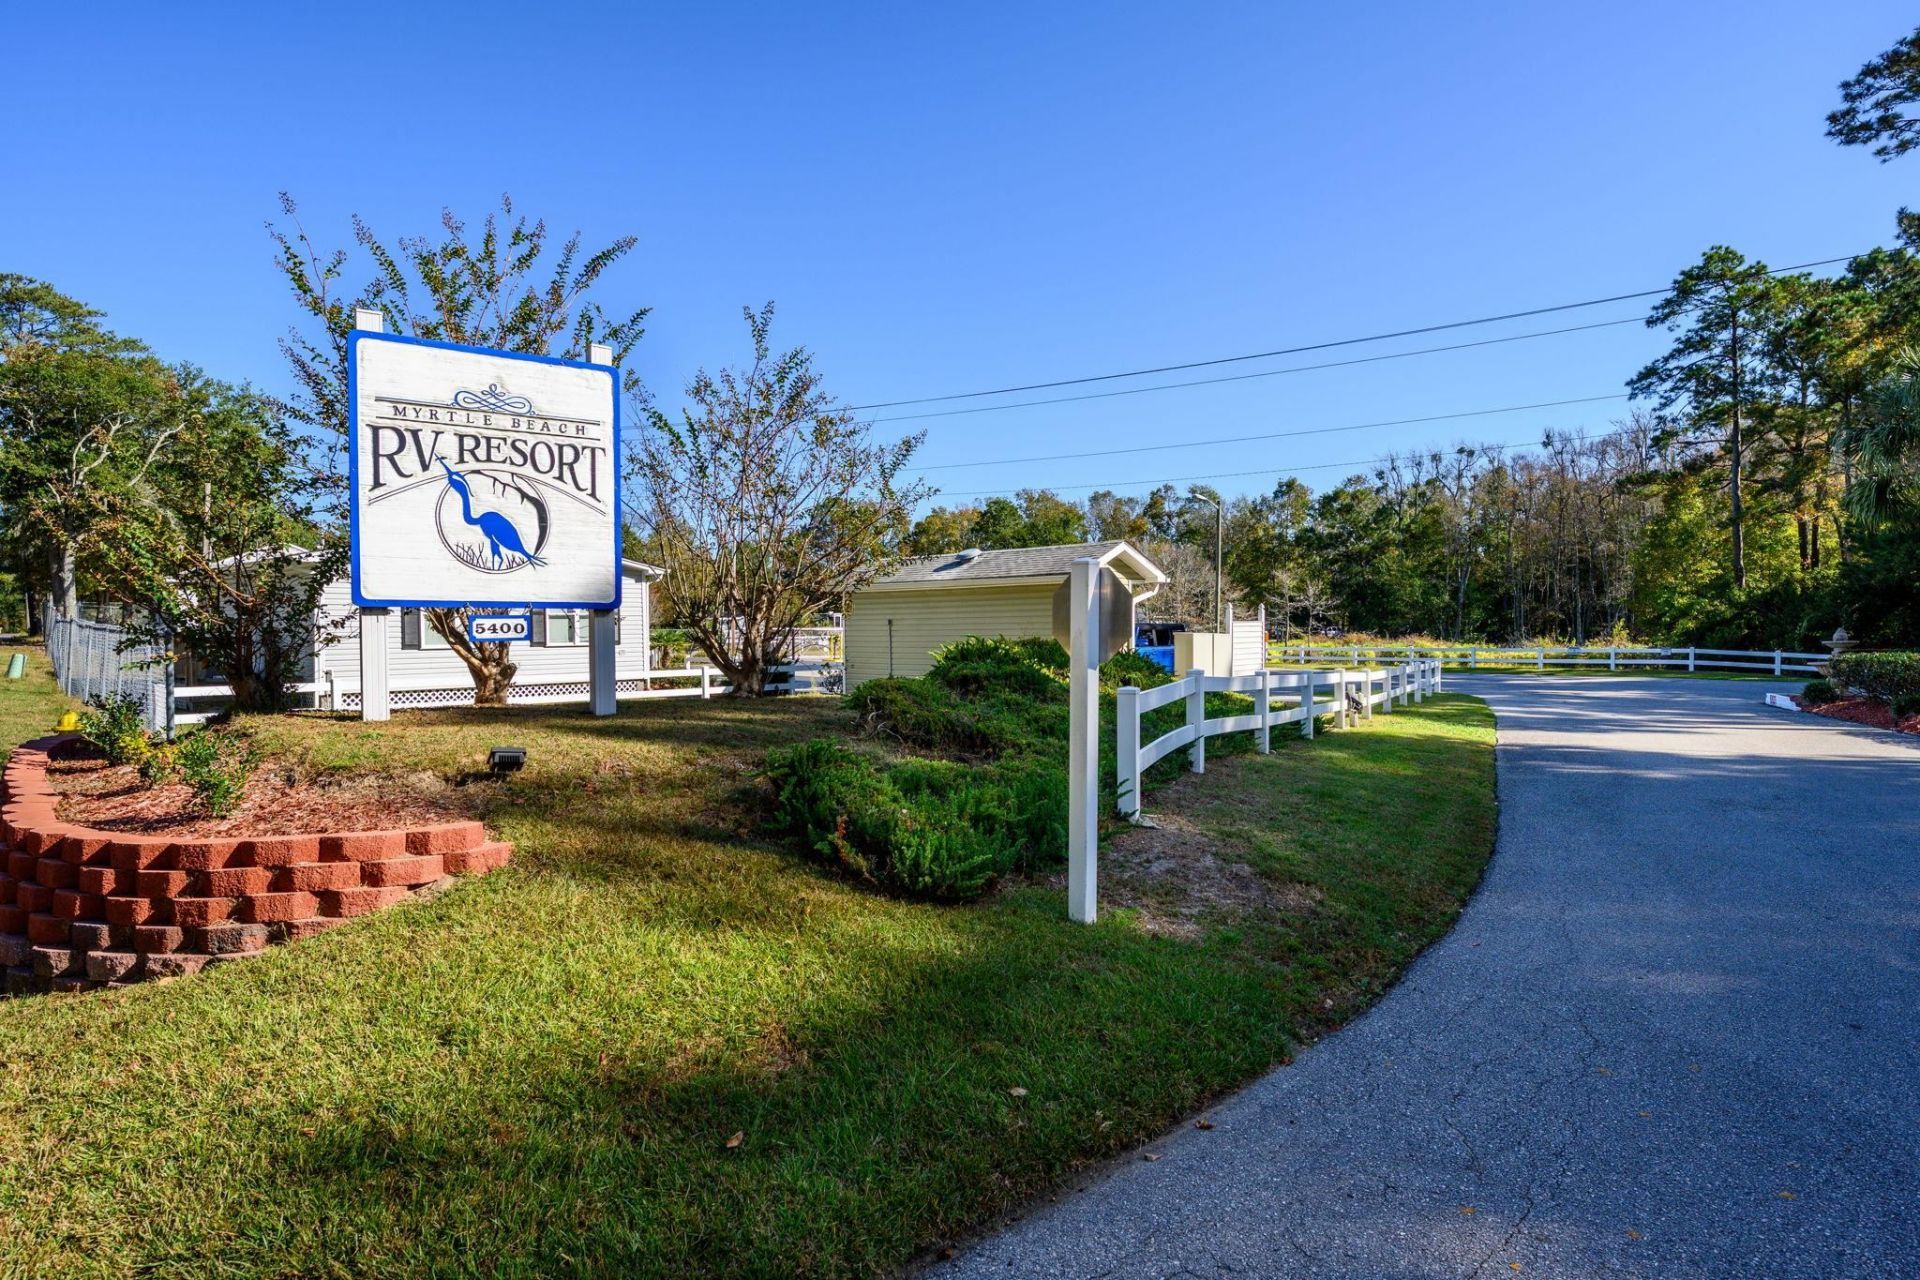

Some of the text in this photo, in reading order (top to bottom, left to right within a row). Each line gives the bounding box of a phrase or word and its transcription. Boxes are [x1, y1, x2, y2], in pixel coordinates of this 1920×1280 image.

[392, 405, 586, 436] MYRTLE BEACH
[365, 423, 607, 504] RV RESORT
[475, 622, 526, 635] 5400
